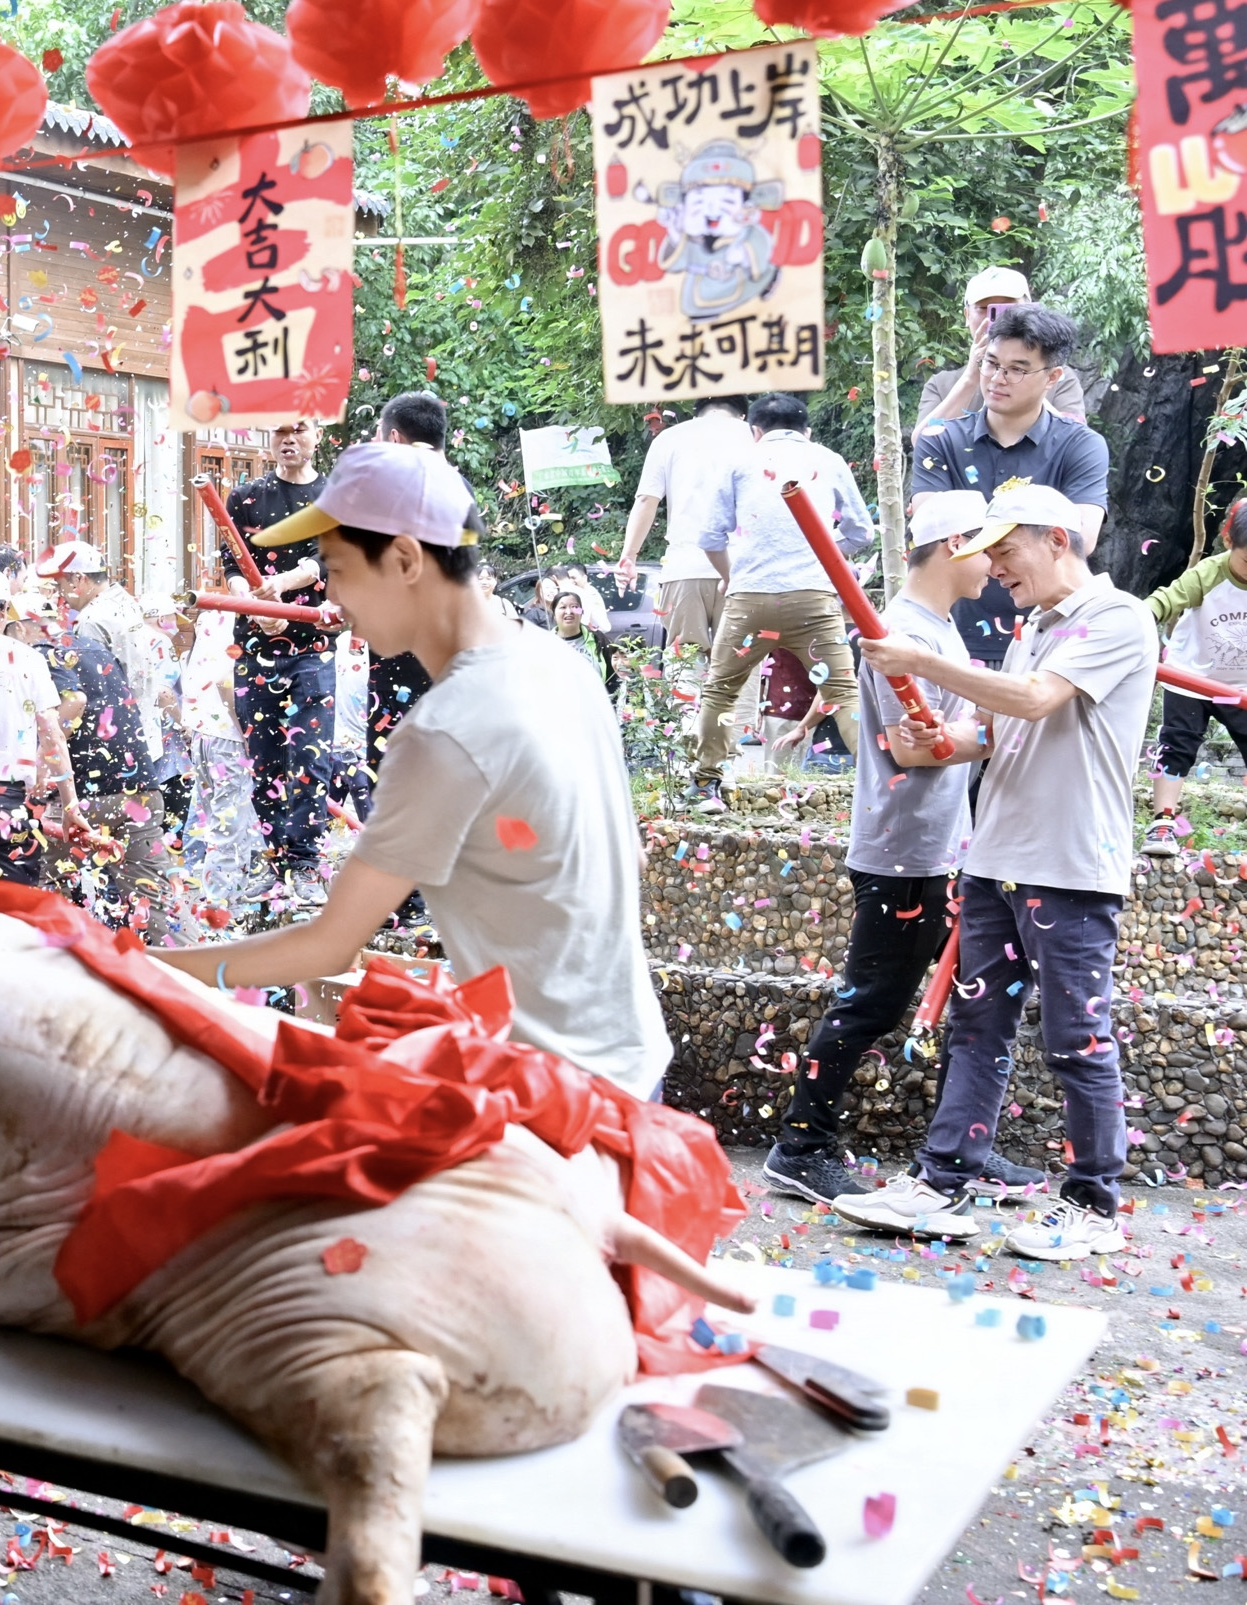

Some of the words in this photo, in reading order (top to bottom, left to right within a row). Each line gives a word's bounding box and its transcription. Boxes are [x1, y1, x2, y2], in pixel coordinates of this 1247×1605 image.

[603, 52, 810, 149] 成功上岸
[234, 171, 290, 380] 大吉大利
